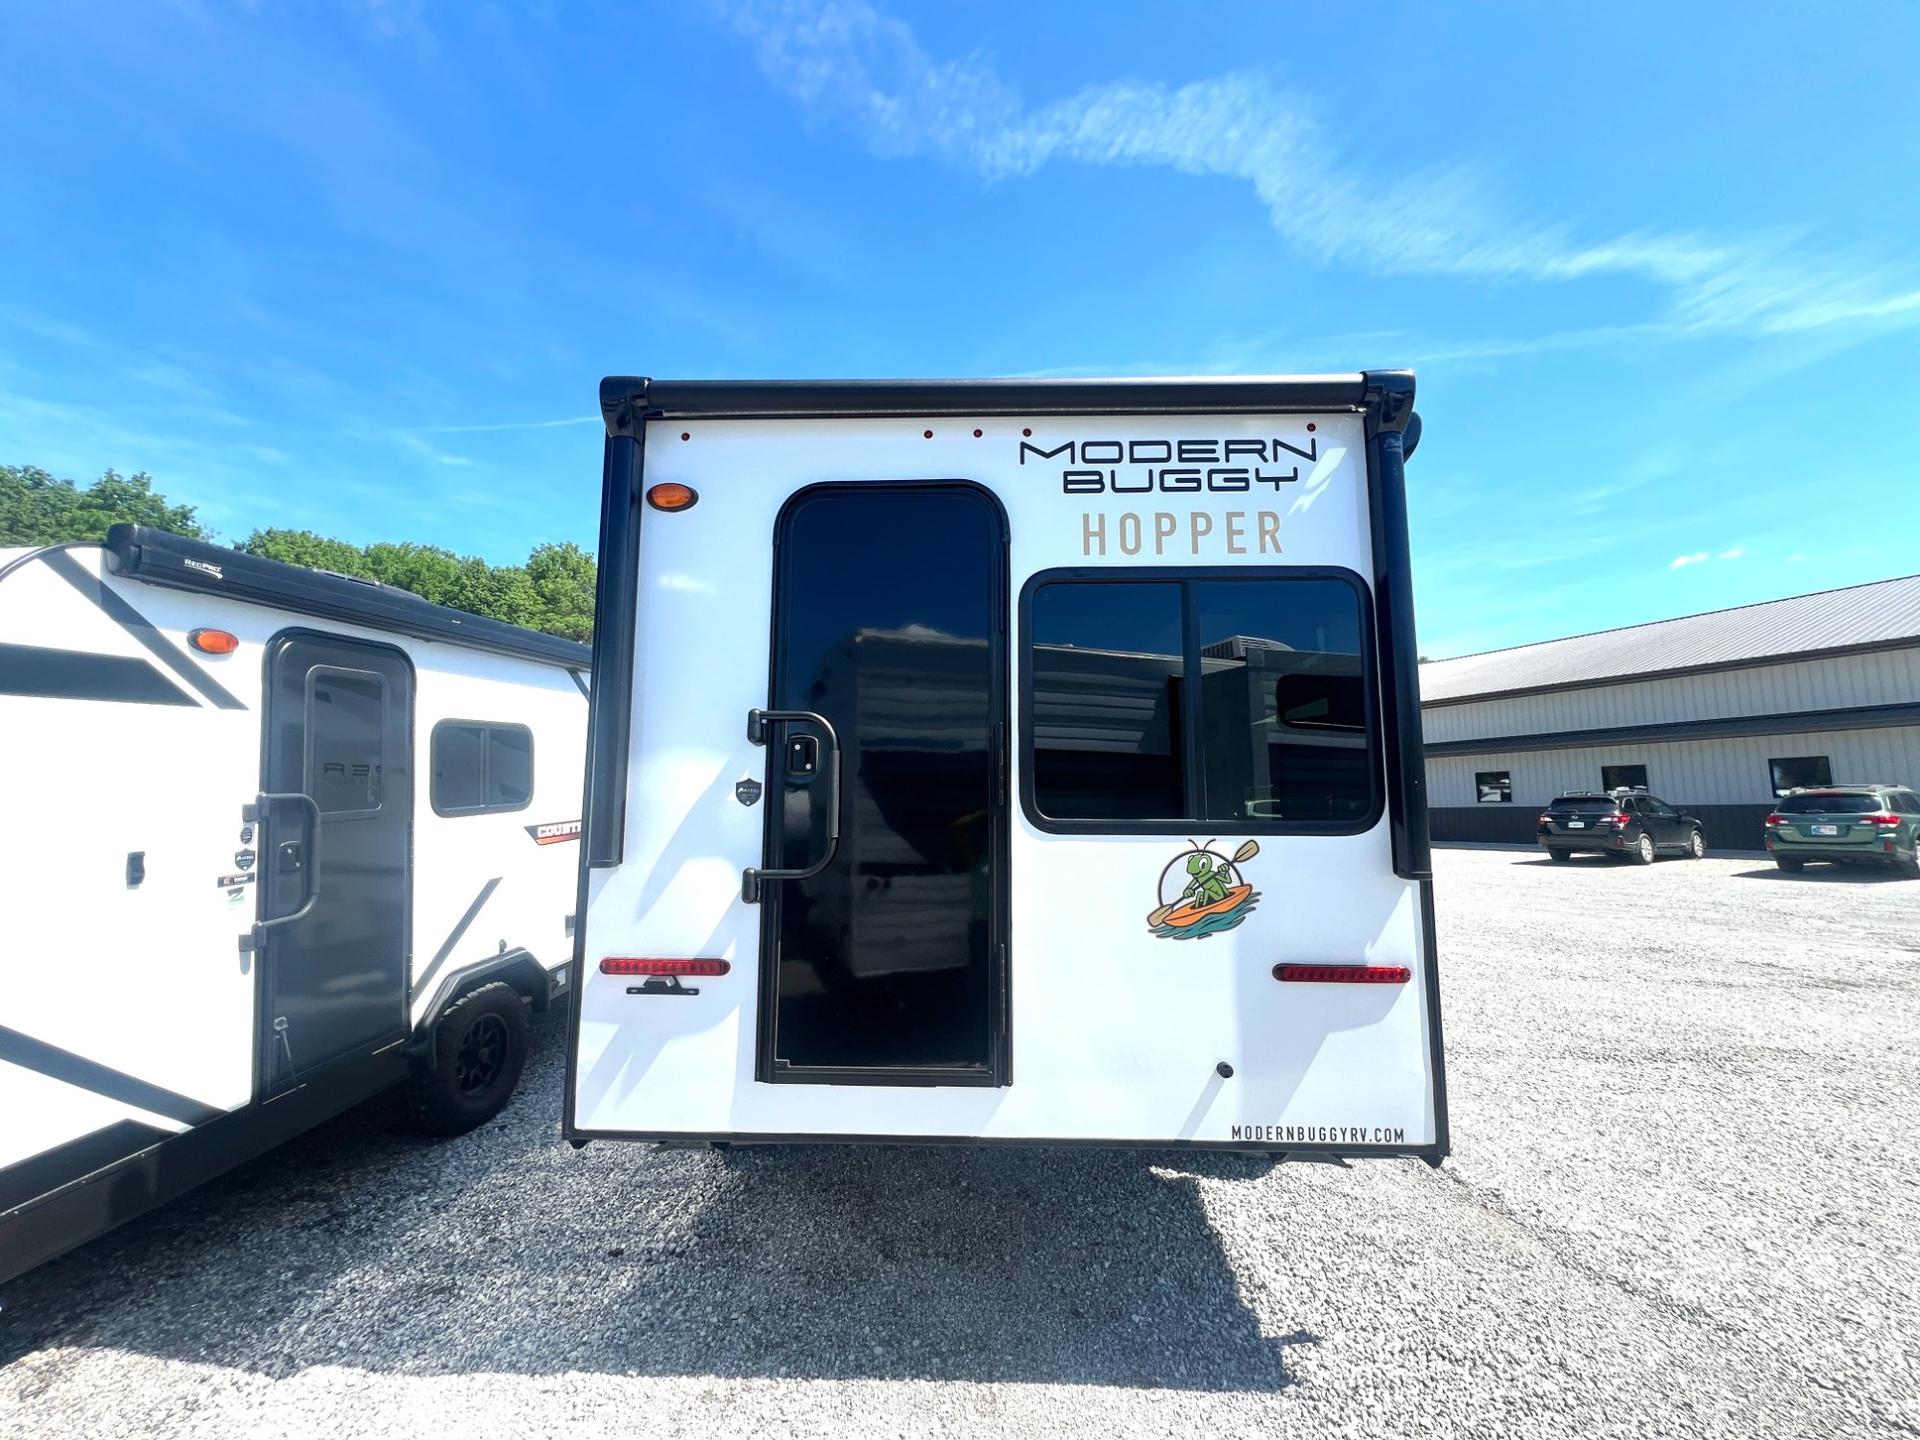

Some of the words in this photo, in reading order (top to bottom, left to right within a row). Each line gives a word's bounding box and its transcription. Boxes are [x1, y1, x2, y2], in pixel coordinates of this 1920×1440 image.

[1019, 438, 1317, 465] MODERN
[1063, 467, 1298, 494] BUGGY
[1082, 511, 1283, 556] HOPPER
[1231, 1125, 1405, 1143] MODERNBUGGYRV.COM
